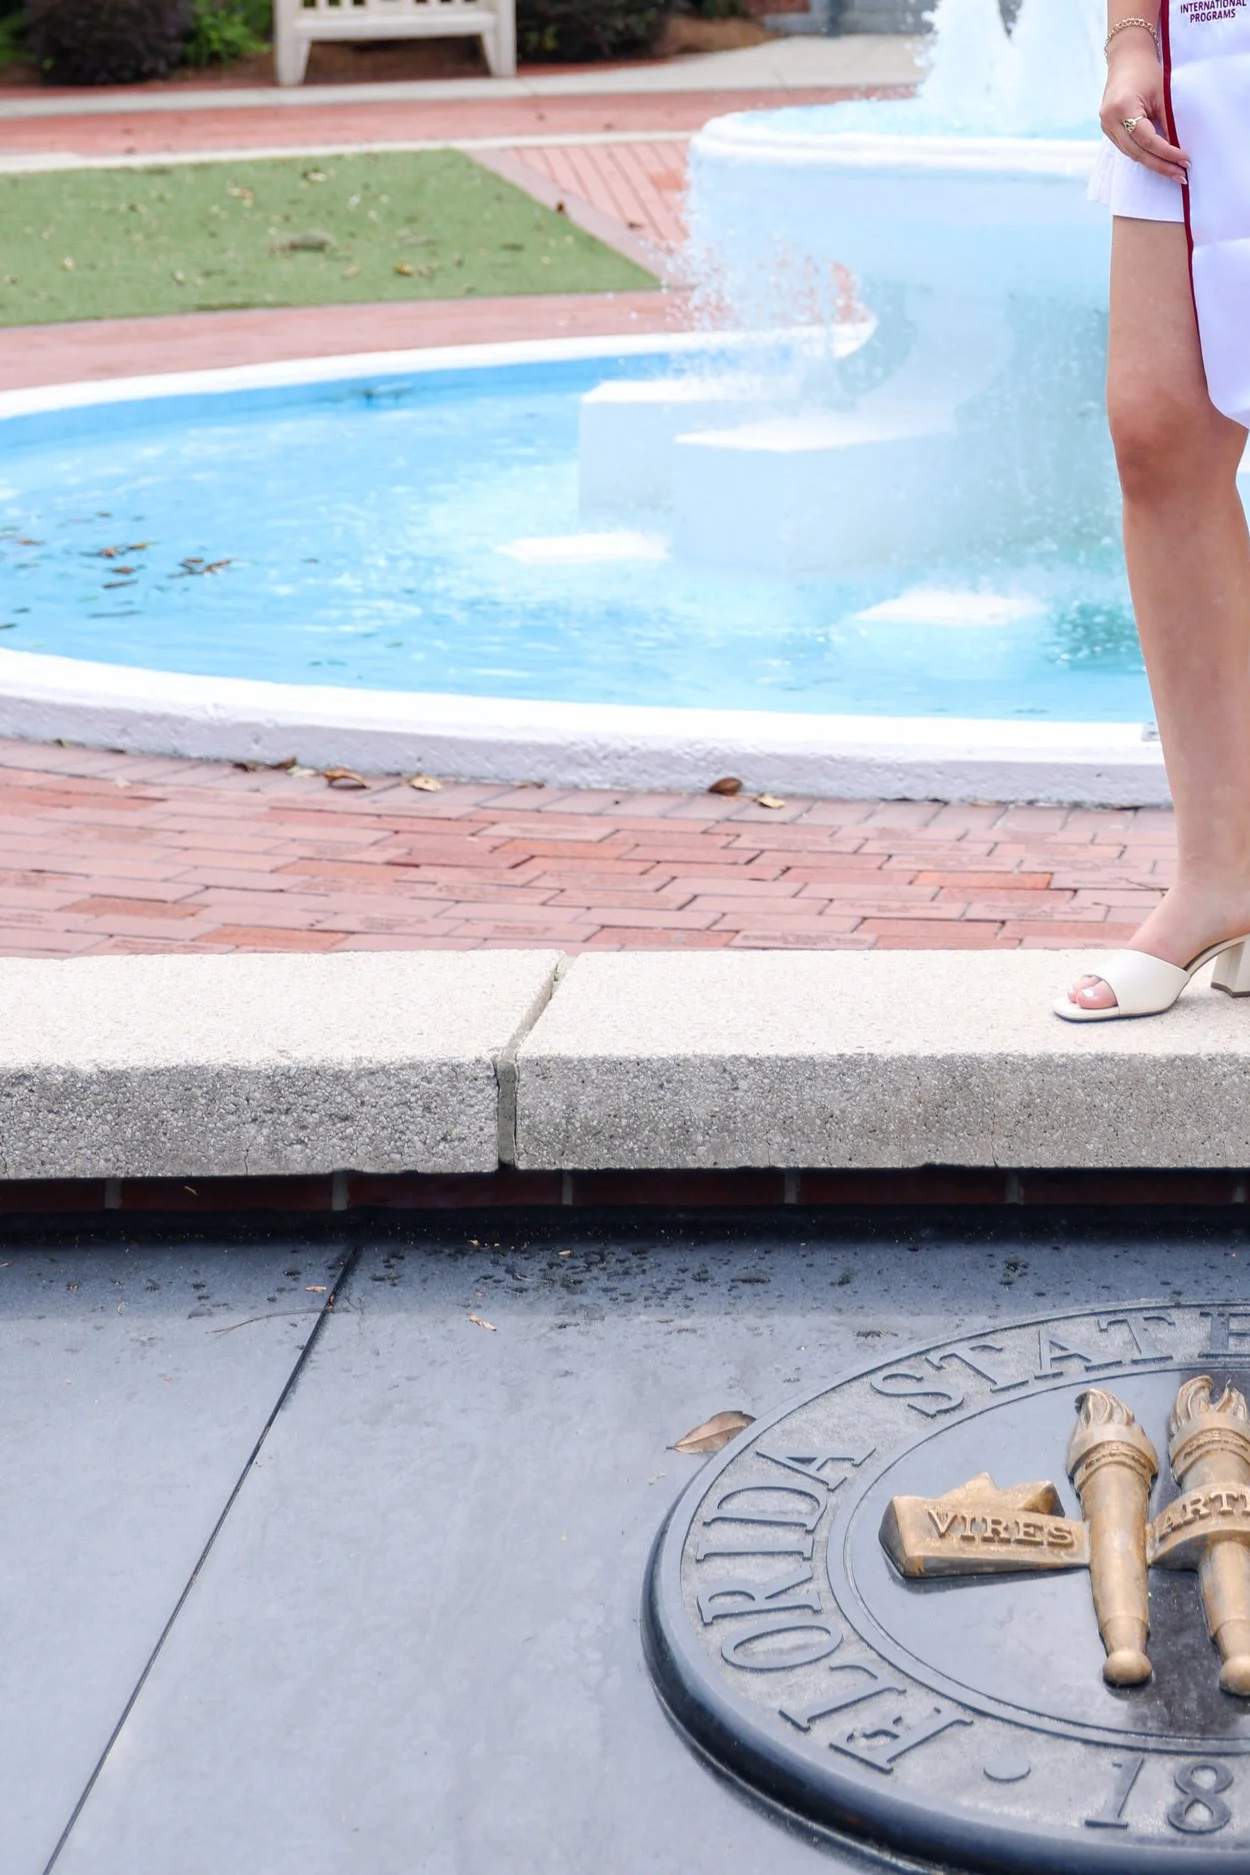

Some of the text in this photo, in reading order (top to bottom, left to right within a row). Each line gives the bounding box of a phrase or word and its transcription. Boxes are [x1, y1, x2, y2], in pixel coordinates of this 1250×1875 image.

[1190, 8, 1236, 23] PROGRAMS
[927, 1508, 1076, 1548] VIRES
[696, 1446, 974, 1774] FLORIDA
